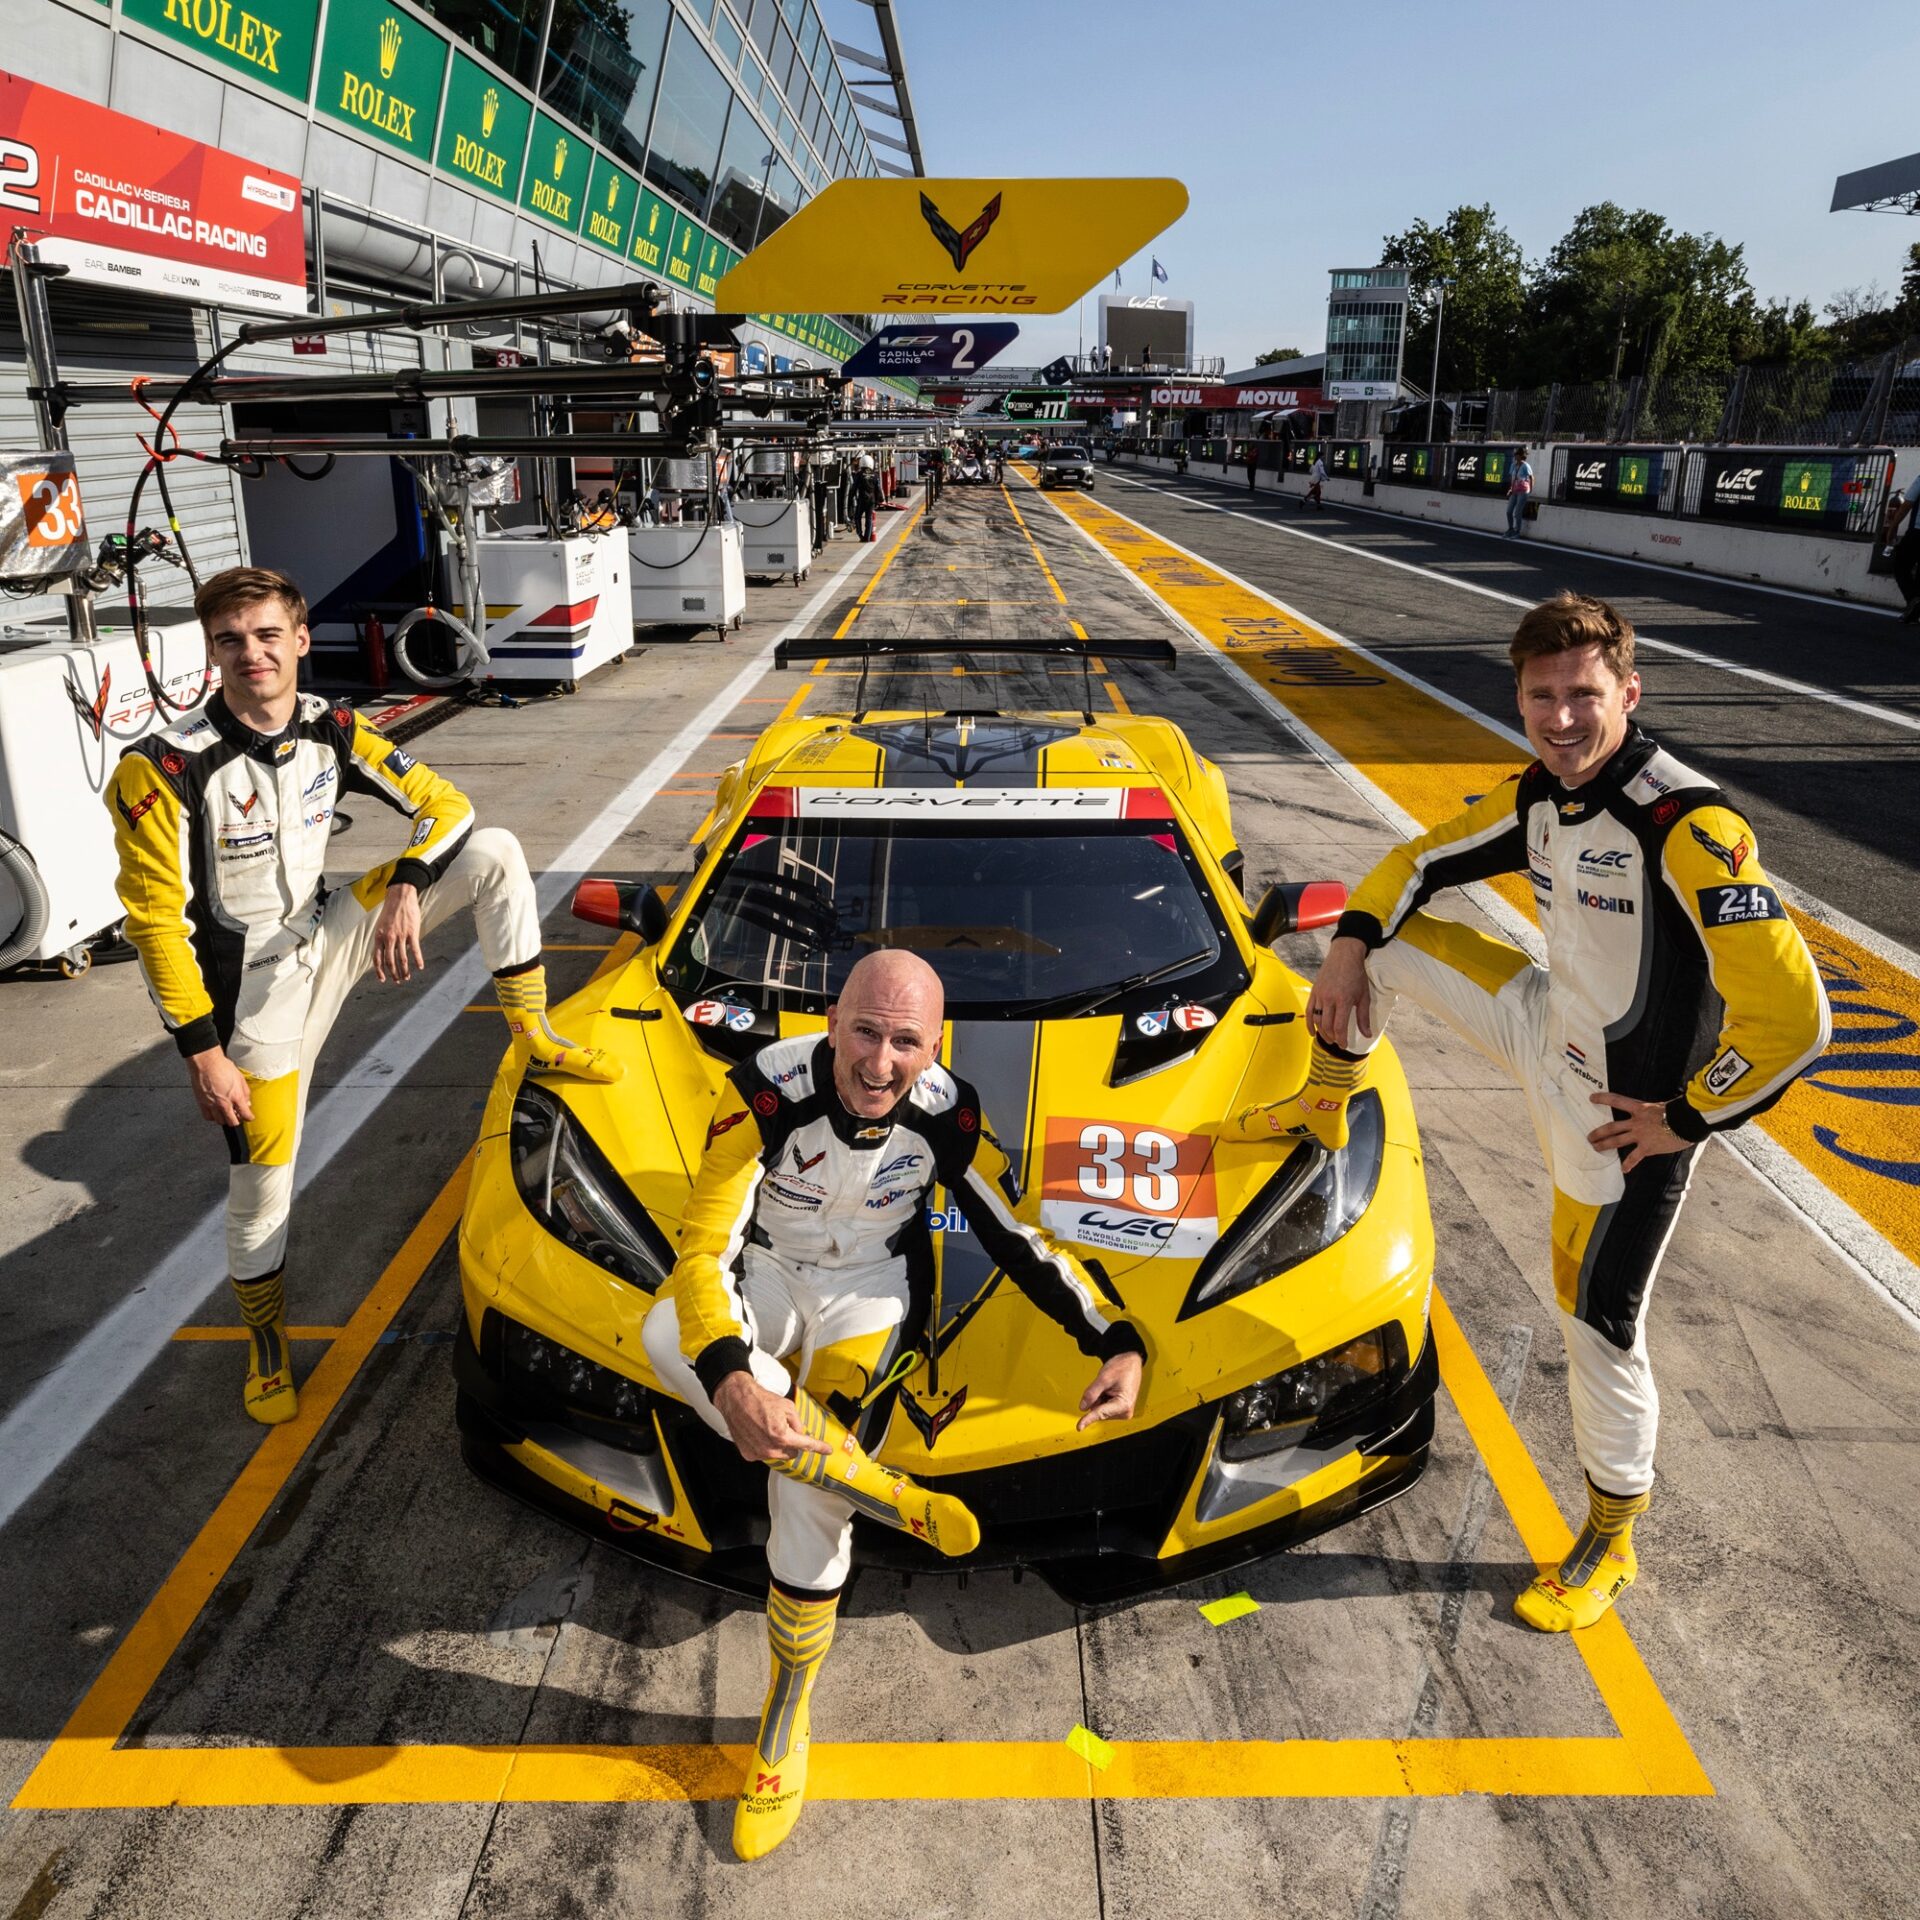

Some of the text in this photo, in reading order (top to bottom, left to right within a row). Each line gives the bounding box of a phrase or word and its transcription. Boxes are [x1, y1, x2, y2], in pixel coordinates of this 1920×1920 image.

[340, 72, 416, 141] ROLEX
[453, 134, 506, 189] ROLEX
[0, 137, 40, 215] 2
[74, 169, 190, 212] CADILLAC V-SERIES.R
[531, 179, 571, 221] ROLEX
[75, 189, 267, 257] CADILLAC RACING
[589, 211, 621, 247] ROLEX
[634, 237, 660, 266] ROLEX
[85, 258, 142, 276] EARL BAMBER
[669, 256, 691, 282] ROLEX
[181, 274, 200, 288] LYNN
[897, 284, 1027, 292] CORVETTE
[246, 287, 282, 301] WESTBROOK
[882, 294, 1038, 305] RACING
[1127, 295, 1168, 309] WEC
[951, 329, 975, 369] 2
[498, 354, 519, 367] 31
[1237, 391, 1299, 405] MOTUL
[1034, 401, 1067, 418] #777
[1575, 461, 1606, 480] WEC
[1717, 469, 1763, 491] WEC
[1621, 483, 1644, 495] ROLEX
[32, 480, 83, 540] 33
[1784, 495, 1822, 511] ROLEX
[809, 795, 1110, 807] CORVETTE
[1579, 849, 1633, 868] WEC
[1578, 889, 1617, 912] Mobil
[1719, 887, 1768, 915] 24h
[1718, 910, 1769, 923] LE MANS
[773, 1066, 798, 1085] Mobil
[1569, 1062, 1604, 1090] Catsburg
[1319, 1100, 1338, 1111] 33
[1078, 1124, 1180, 1212] 33
[1079, 1211, 1179, 1240] WEC
[1077, 1234, 1139, 1251] CHAMPIONSHIP
[1078, 1228, 1172, 1250] FIA WORLD ENDURANCE
[756, 1789, 800, 1806] CONNECT
[746, 1804, 783, 1815] DIGITAL
